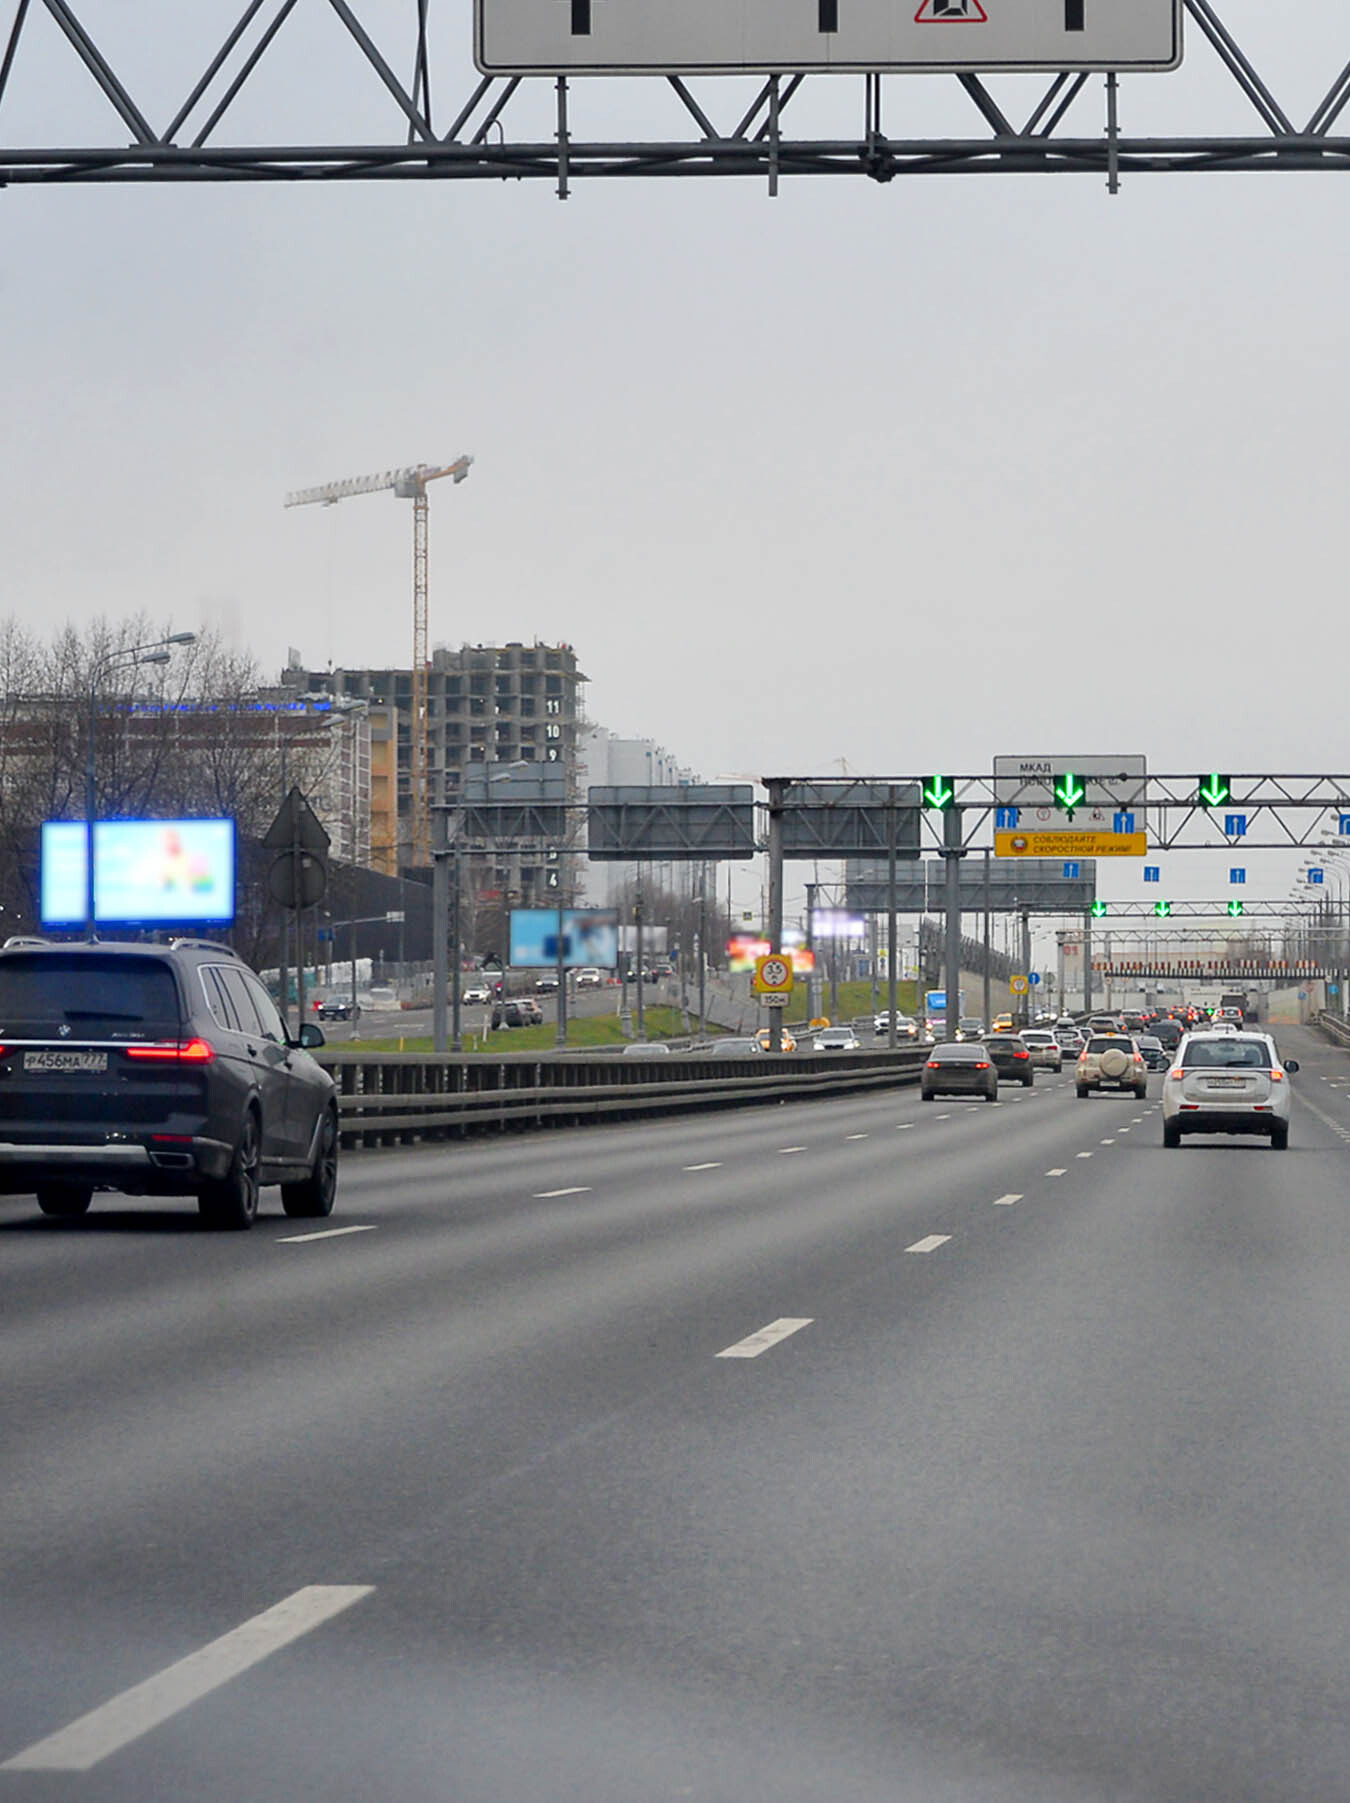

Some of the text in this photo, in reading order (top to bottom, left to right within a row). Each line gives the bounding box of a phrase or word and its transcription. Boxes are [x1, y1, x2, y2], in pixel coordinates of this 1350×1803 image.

[546, 700, 559, 713] 11
[546, 725, 560, 738] 10
[549, 750, 558, 762] 9
[1019, 763, 1052, 774] МКАД
